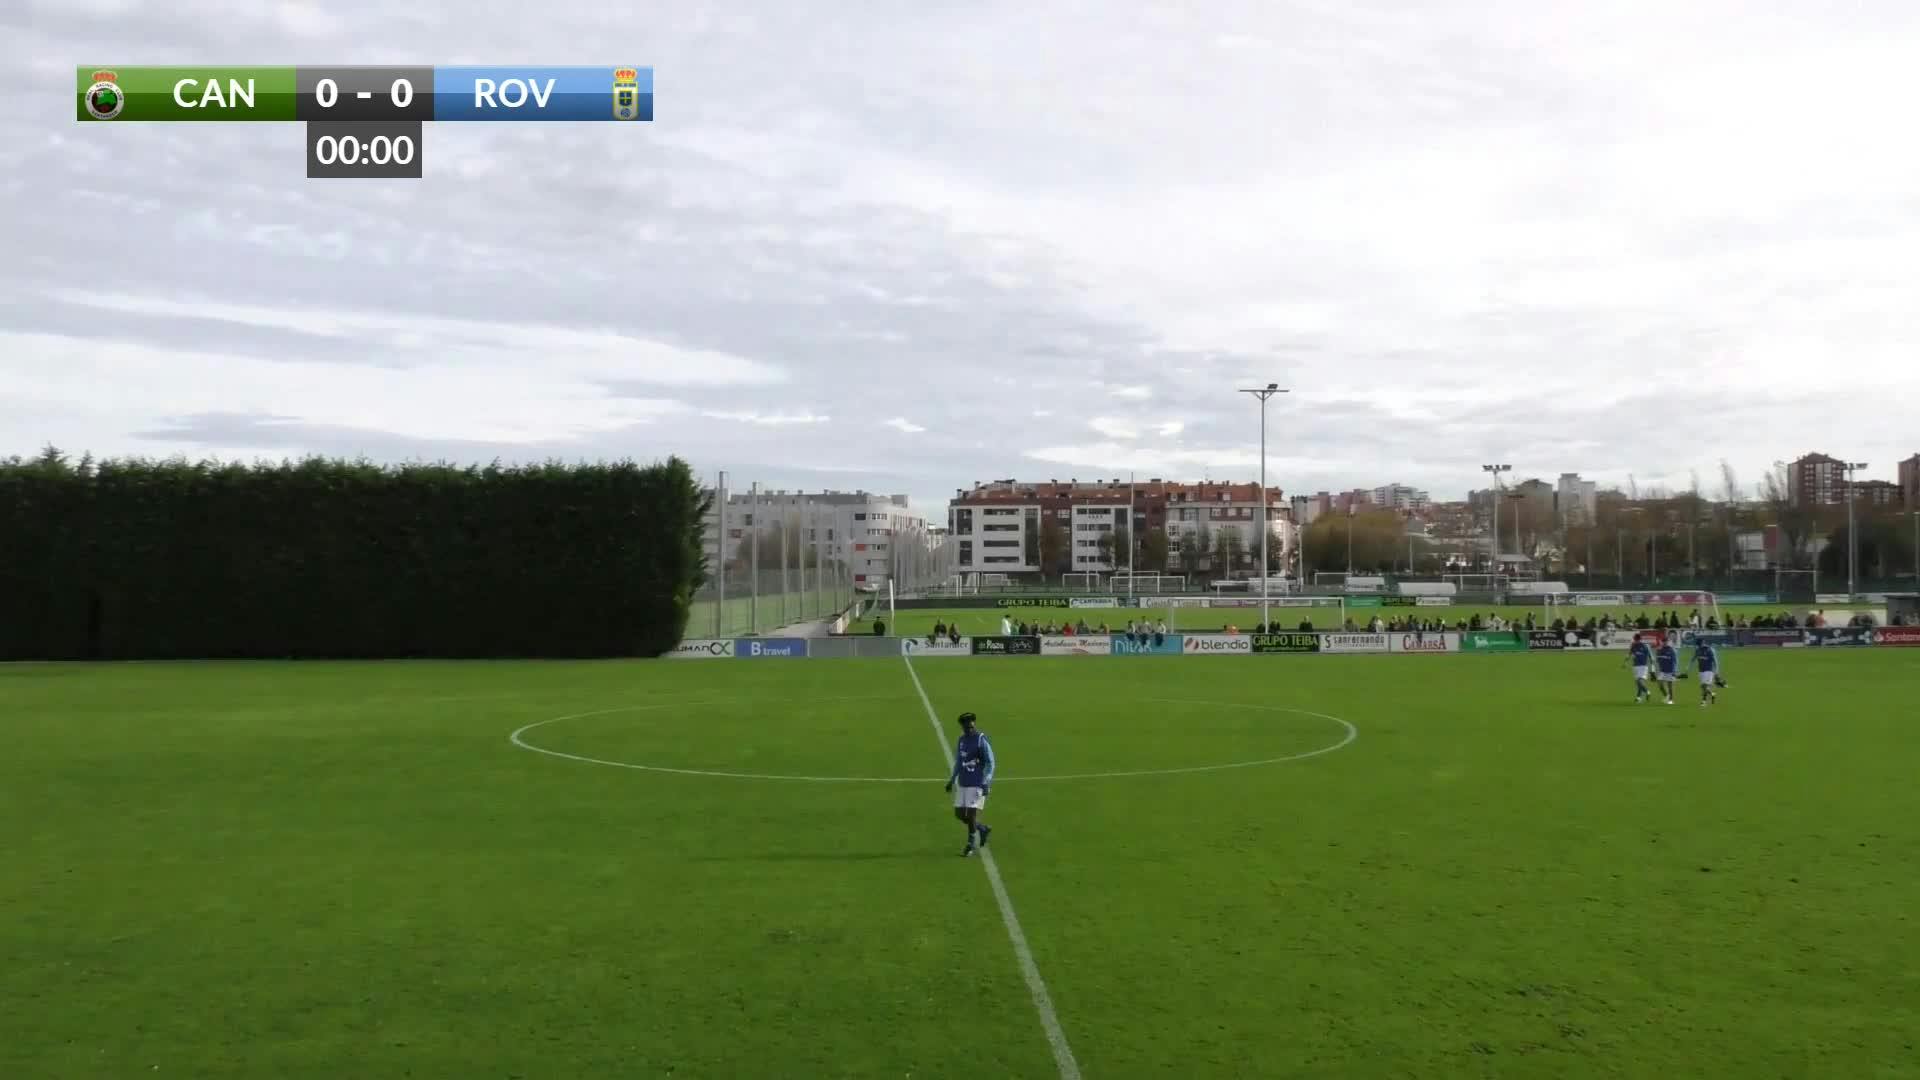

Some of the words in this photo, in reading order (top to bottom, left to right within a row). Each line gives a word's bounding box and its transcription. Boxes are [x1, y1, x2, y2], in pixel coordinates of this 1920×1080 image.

[1201, 639, 1249, 650] blendio
[1253, 635, 1288, 646] GRUPO
[1292, 635, 1319, 646] TEIBA
[751, 641, 761, 656] B
[763, 646, 791, 656] travel
